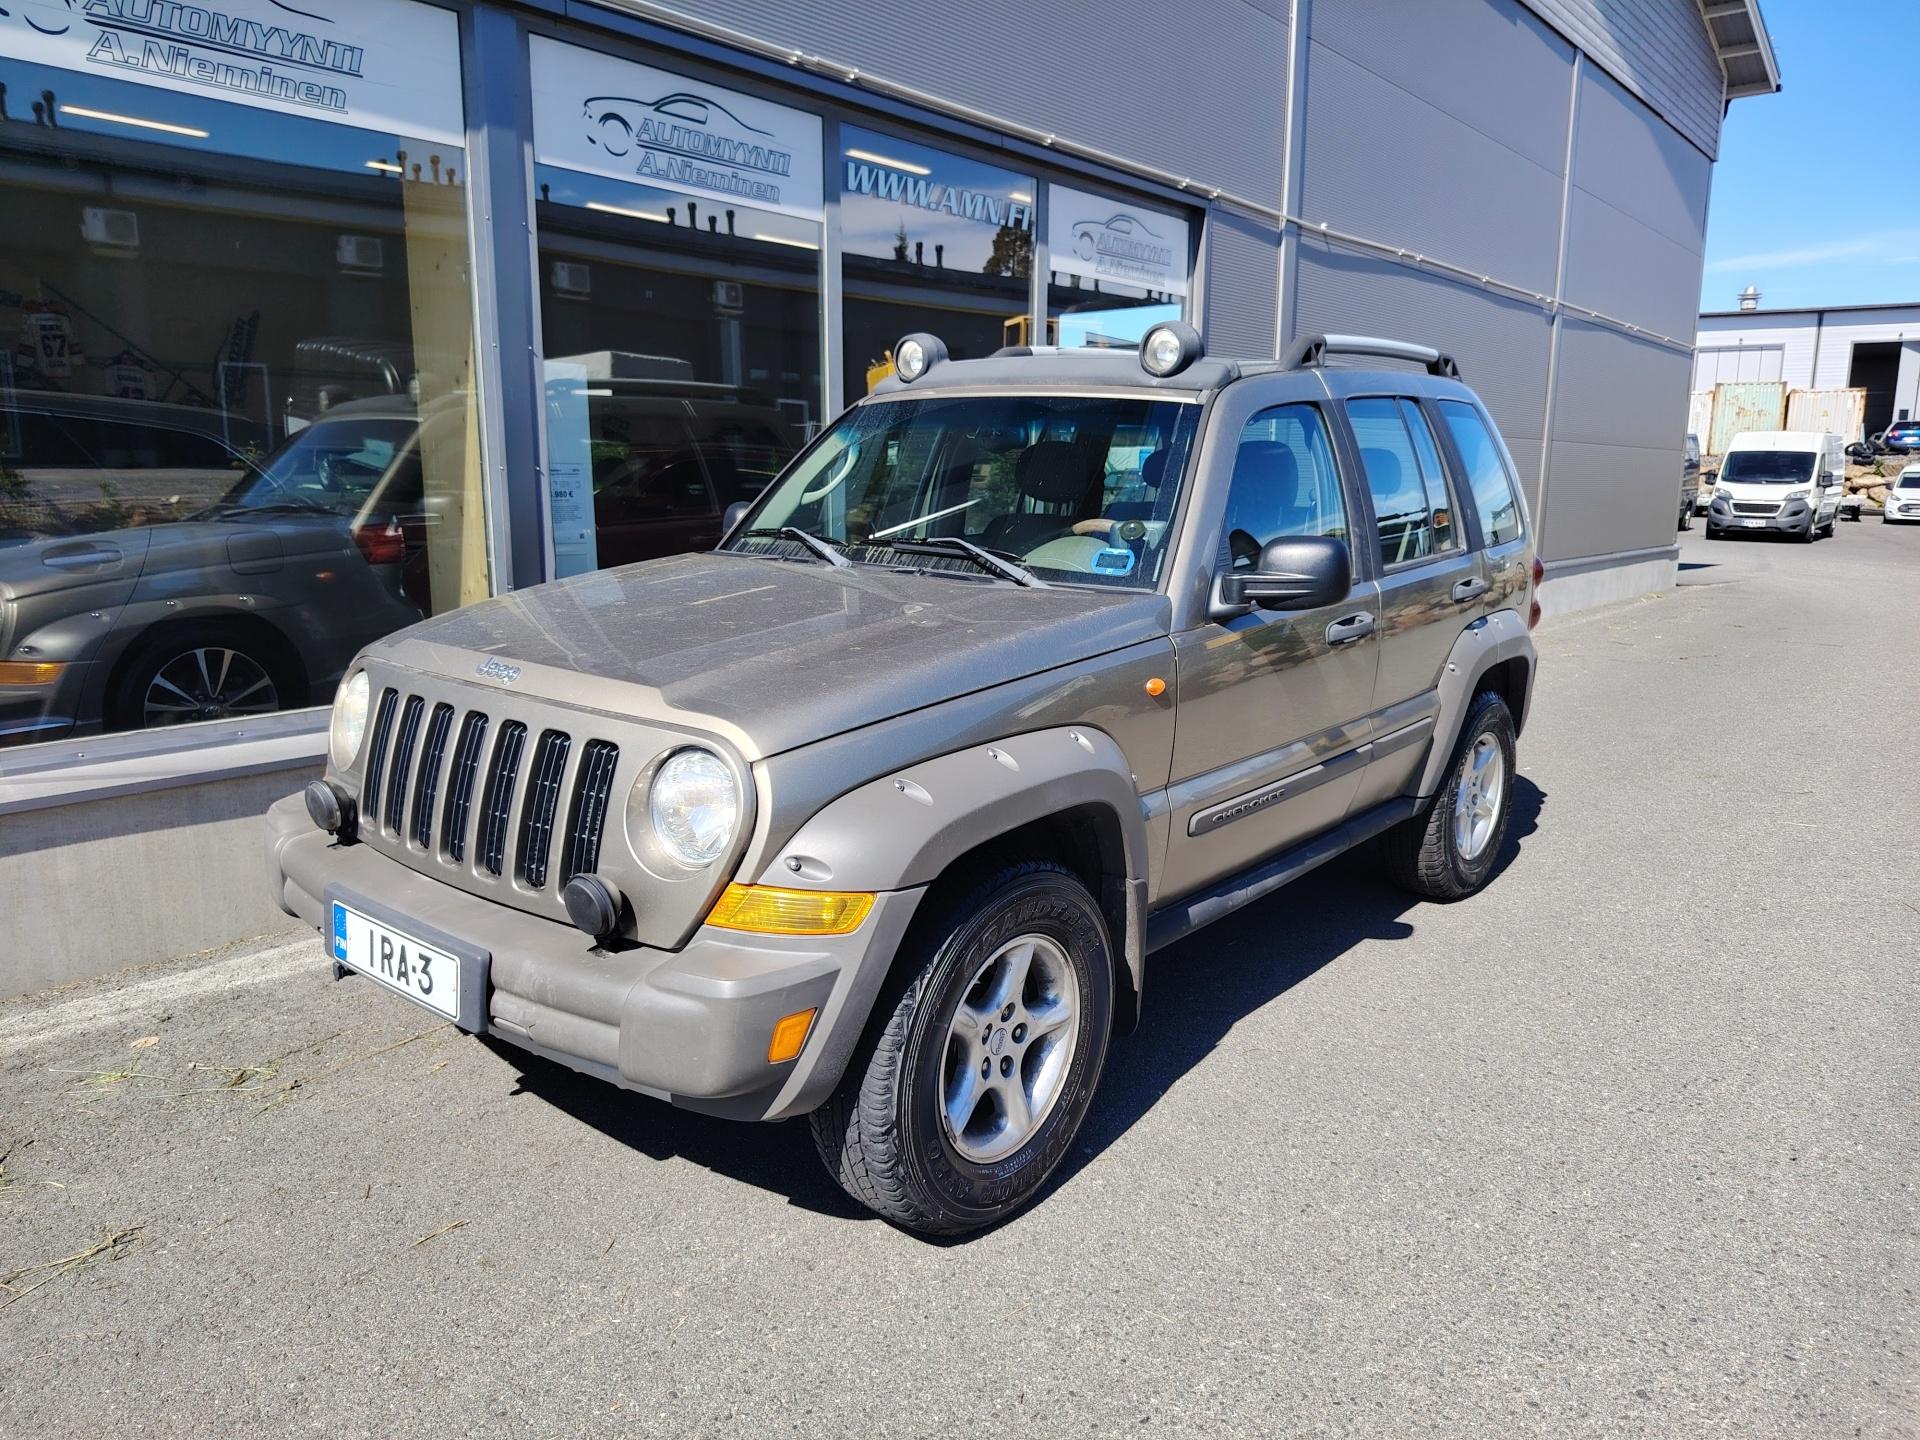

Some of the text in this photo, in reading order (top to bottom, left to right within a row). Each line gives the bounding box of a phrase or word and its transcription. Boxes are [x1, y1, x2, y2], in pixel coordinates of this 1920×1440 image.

[82, 0, 364, 73] AUTOMYYNTI
[87, 30, 348, 110] A.Nieminen
[635, 117, 792, 175] AUTOMYYNTI
[636, 151, 782, 201] A.Nieminen
[847, 160, 1032, 231] WWW.AMN.FI
[476, 655, 522, 685] Jeep
[369, 928, 434, 996] IRA-3
